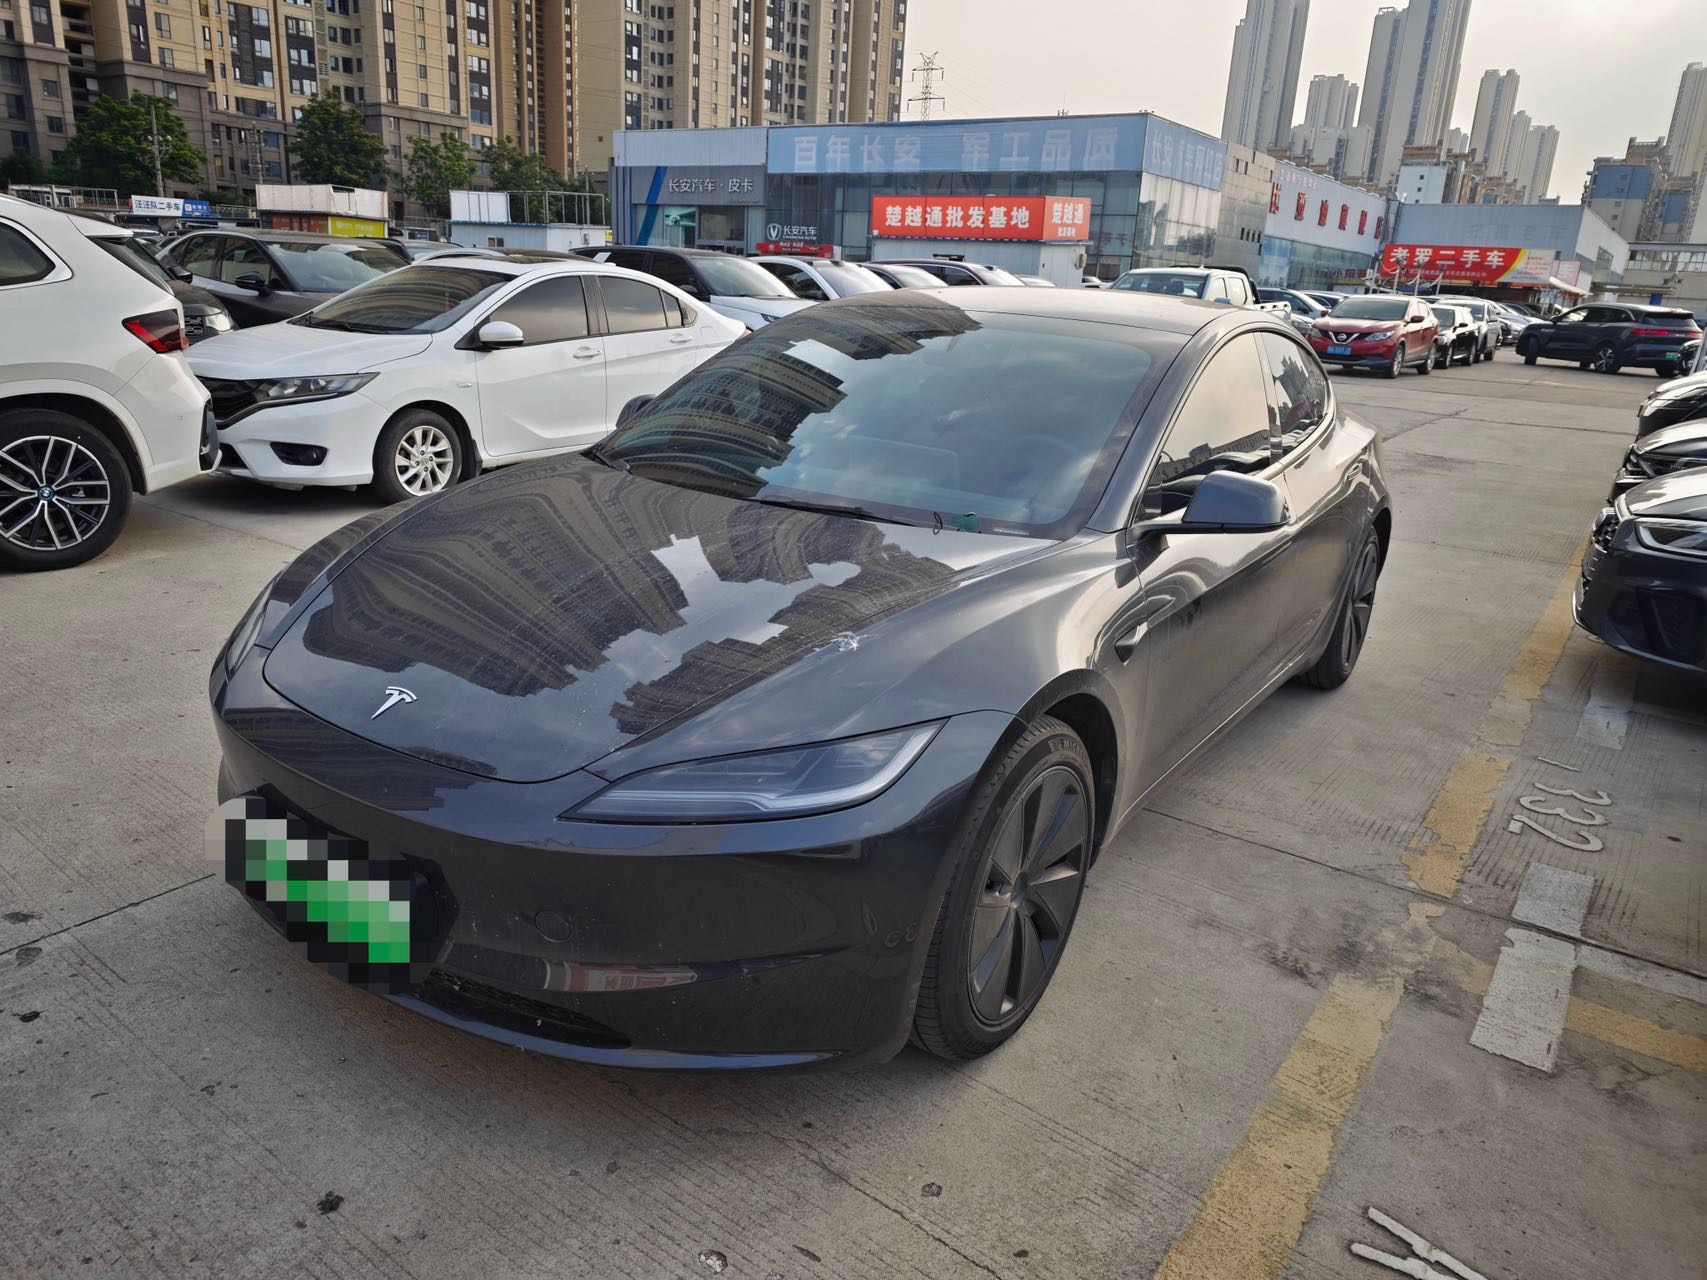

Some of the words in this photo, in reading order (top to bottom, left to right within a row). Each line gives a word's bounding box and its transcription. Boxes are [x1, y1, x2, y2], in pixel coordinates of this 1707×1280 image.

[794, 134, 921, 168] 百年长安
[961, 128, 1118, 165] 军工品质
[885, 205, 1030, 228] 楚越通批发基地
[1052, 202, 1084, 224] 楚越通
[783, 226, 816, 235] 长安汽车
[1390, 247, 1506, 269] 老罗二手车
